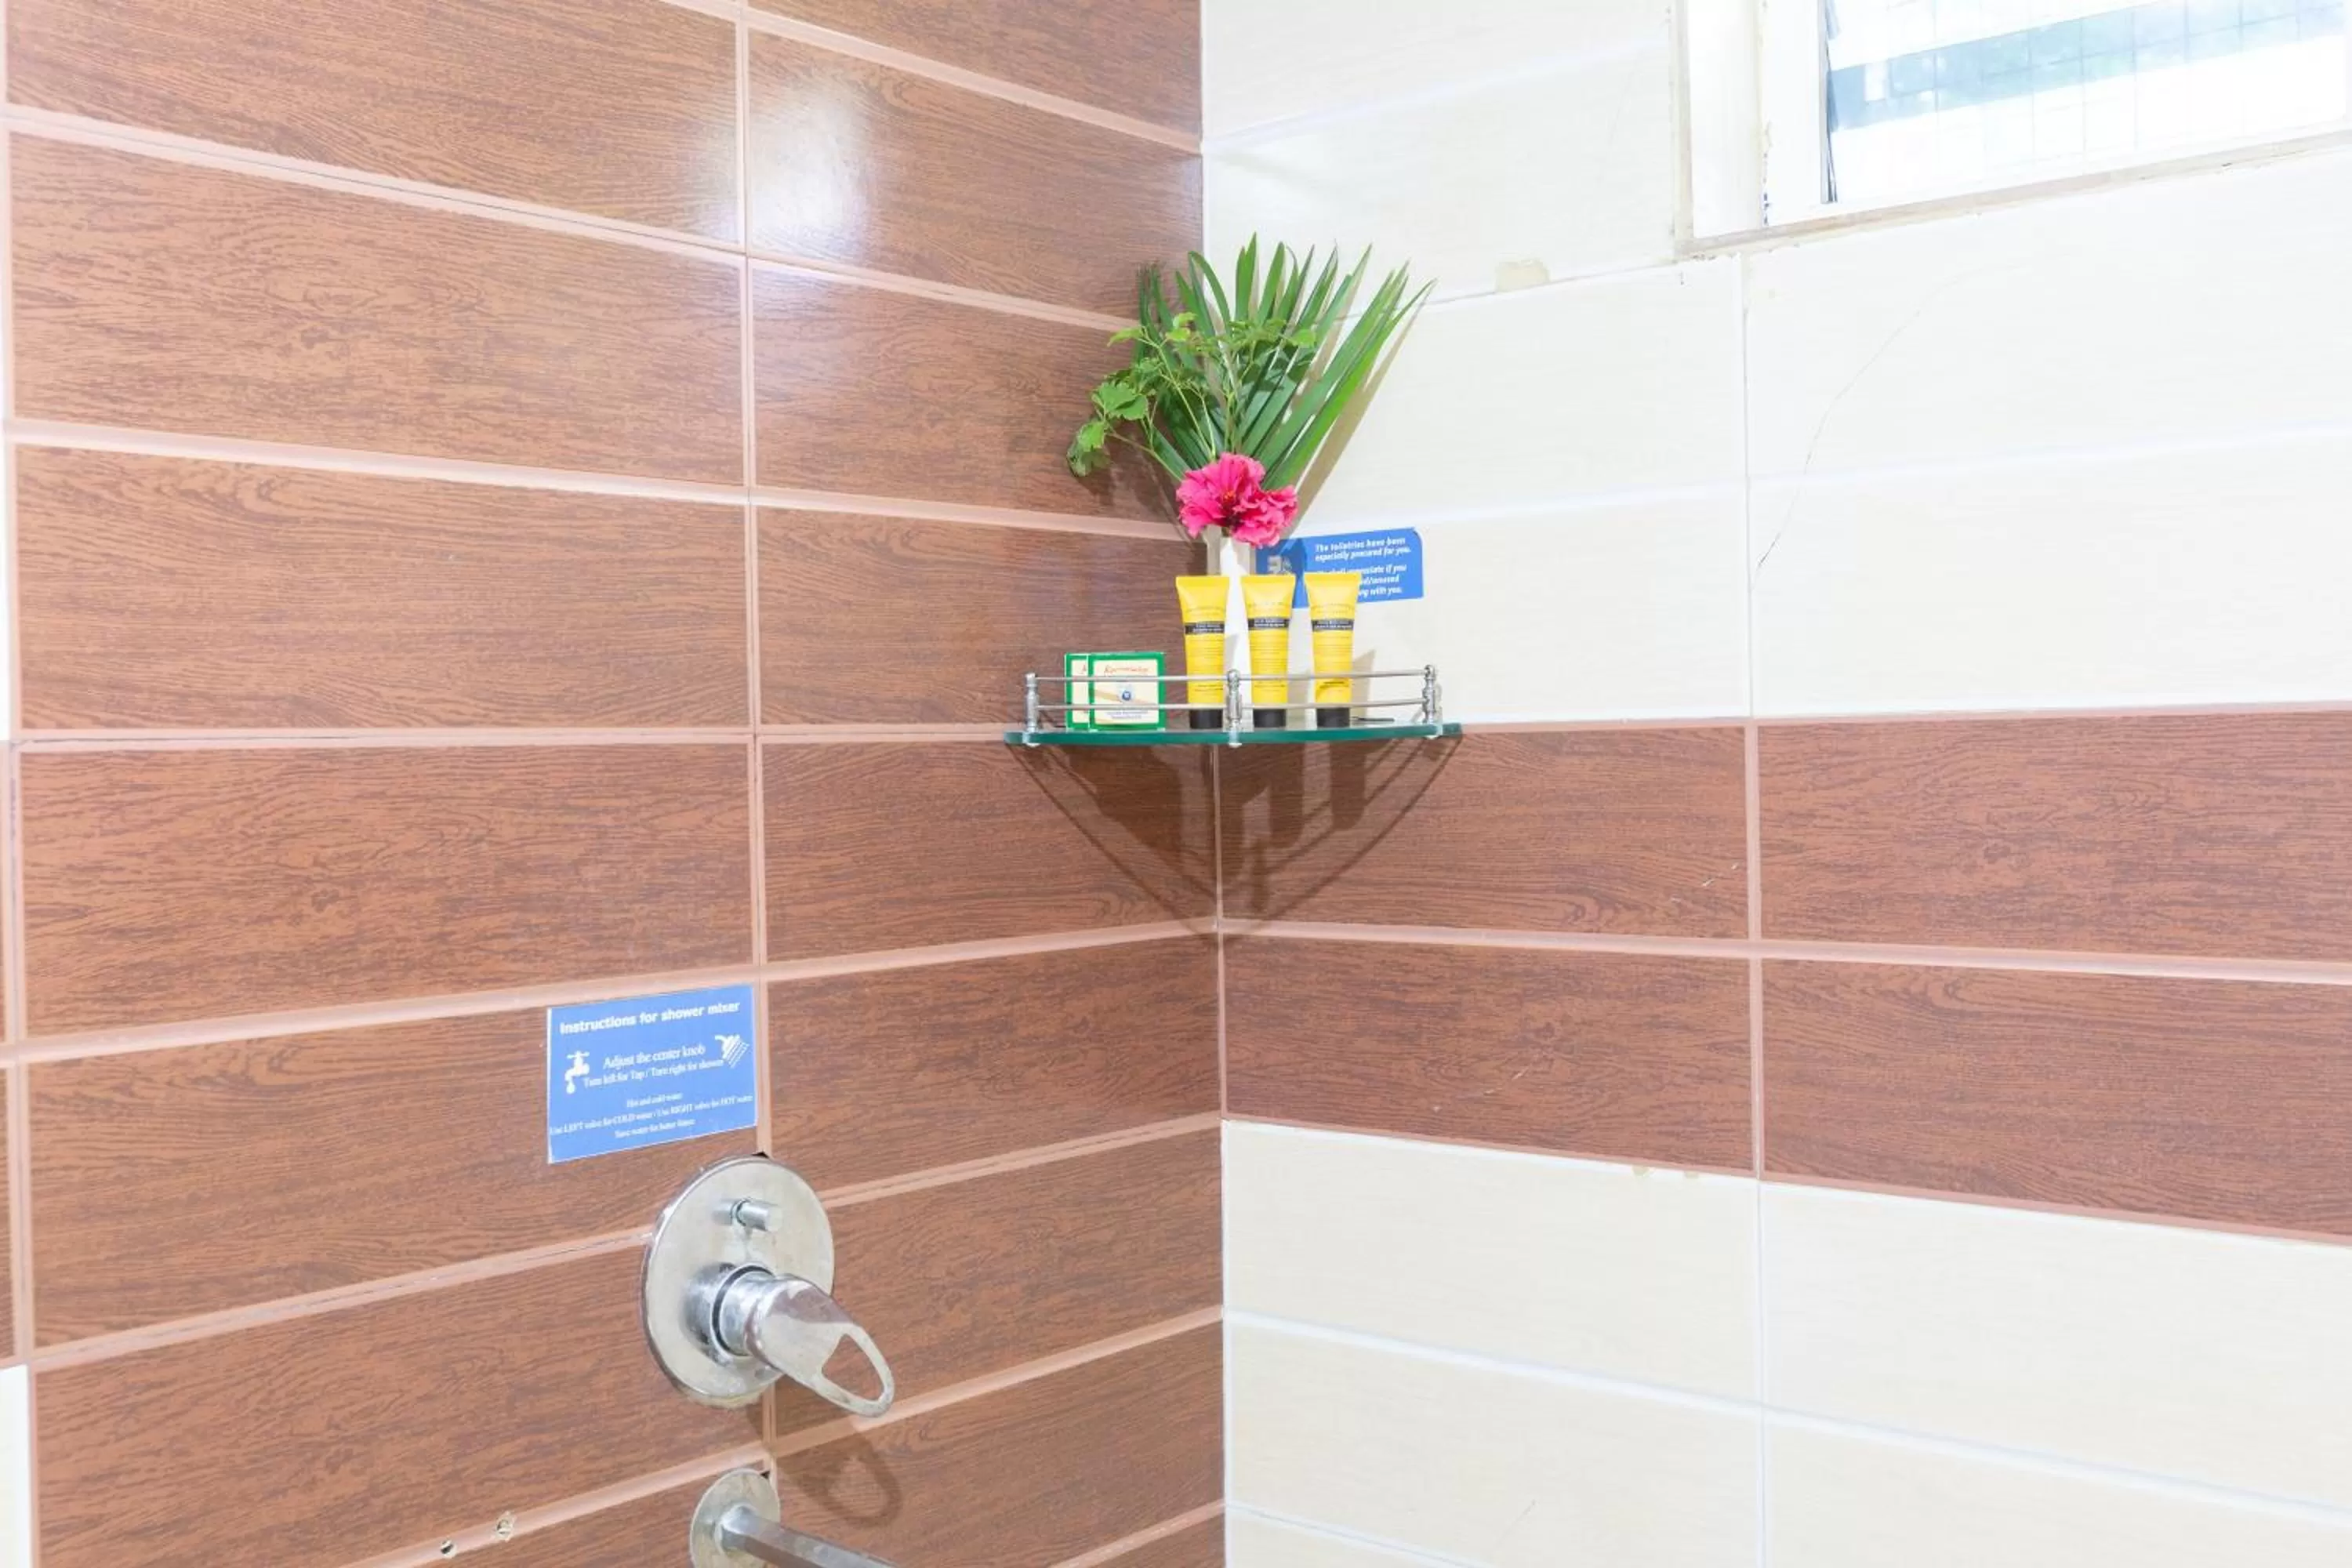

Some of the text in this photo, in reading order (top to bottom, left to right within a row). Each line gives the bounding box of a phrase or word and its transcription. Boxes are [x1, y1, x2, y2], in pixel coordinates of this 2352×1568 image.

[560, 1015, 637, 1035] Instructions
[638, 1011, 658, 1025] for
[661, 1005, 705, 1022] shower
[603, 1054, 634, 1070] Adjust
[636, 1051, 652, 1064] the
[682, 1044, 706, 1058] knob
